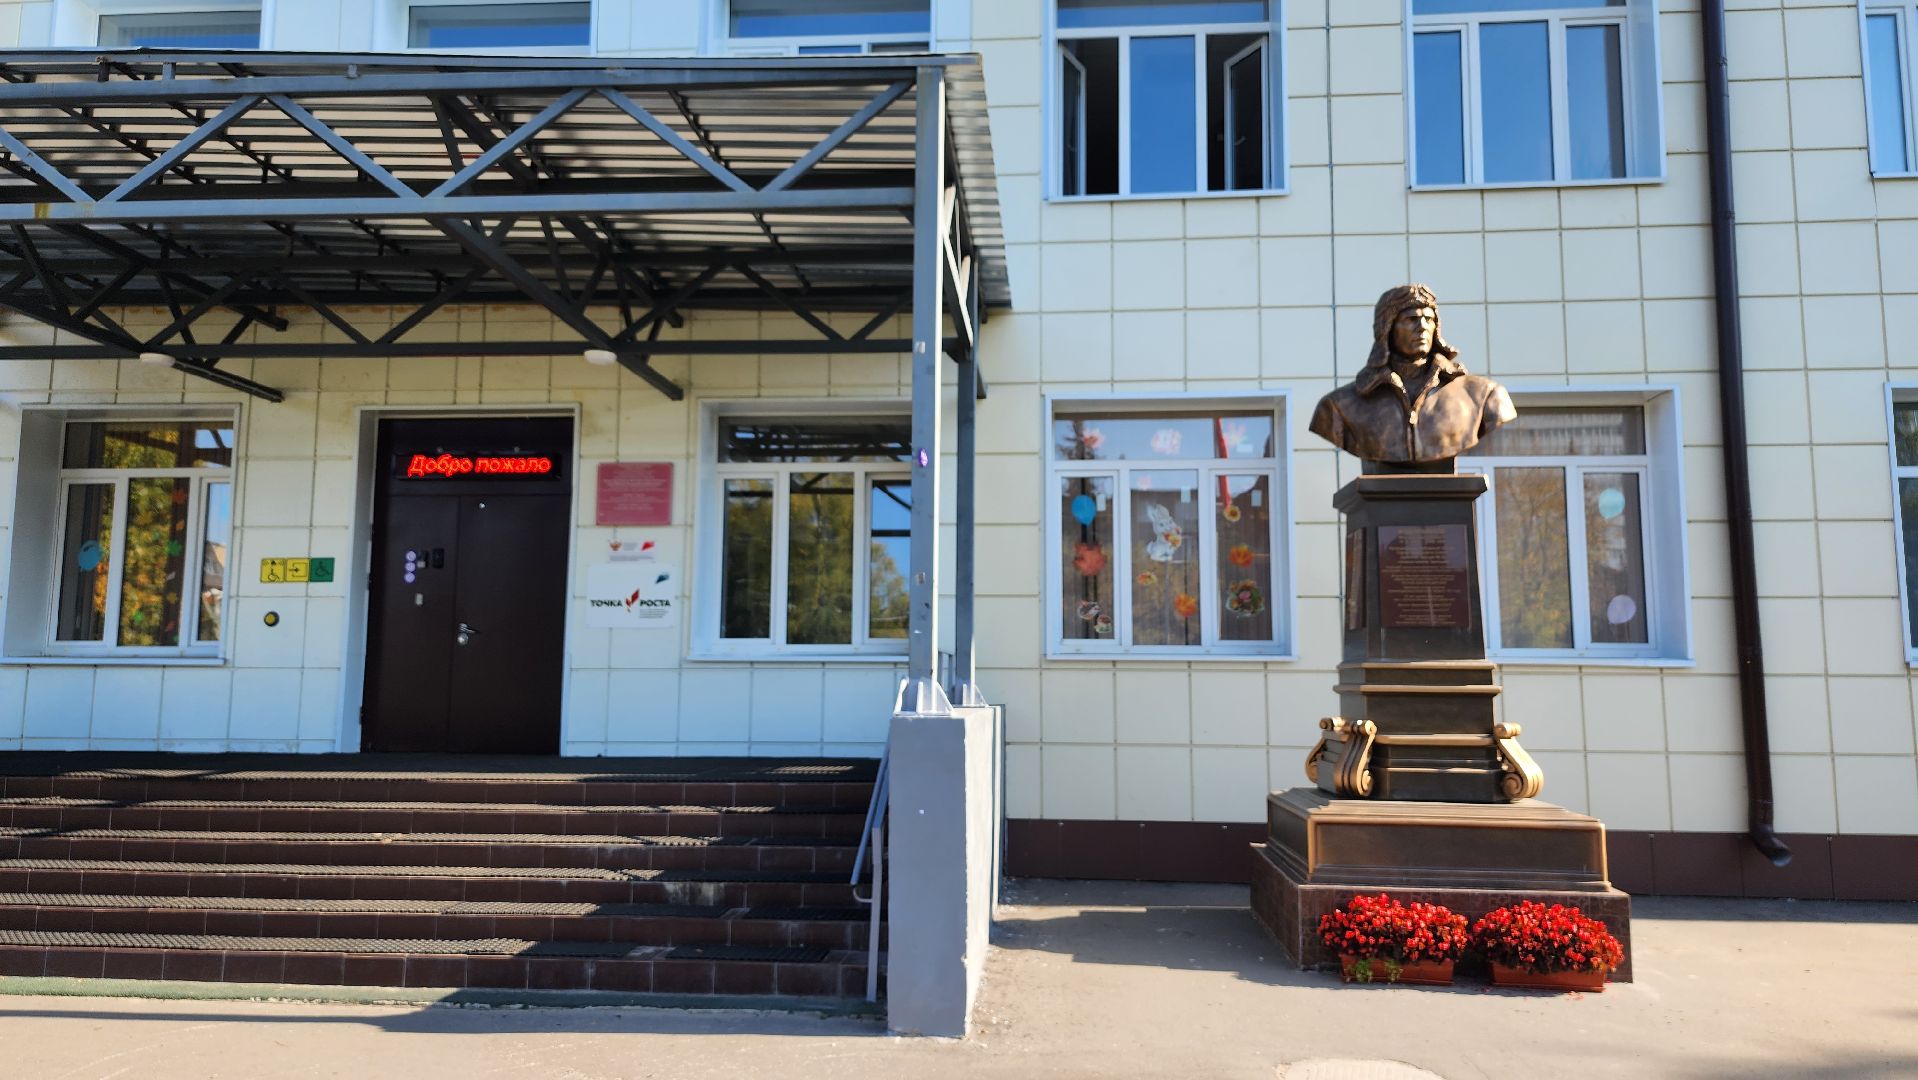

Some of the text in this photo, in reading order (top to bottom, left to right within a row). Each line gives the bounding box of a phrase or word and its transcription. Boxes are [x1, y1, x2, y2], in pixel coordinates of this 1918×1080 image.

[408, 454, 552, 477] Добро пожало
[590, 599, 671, 607] ТОЧКА РОСТА
